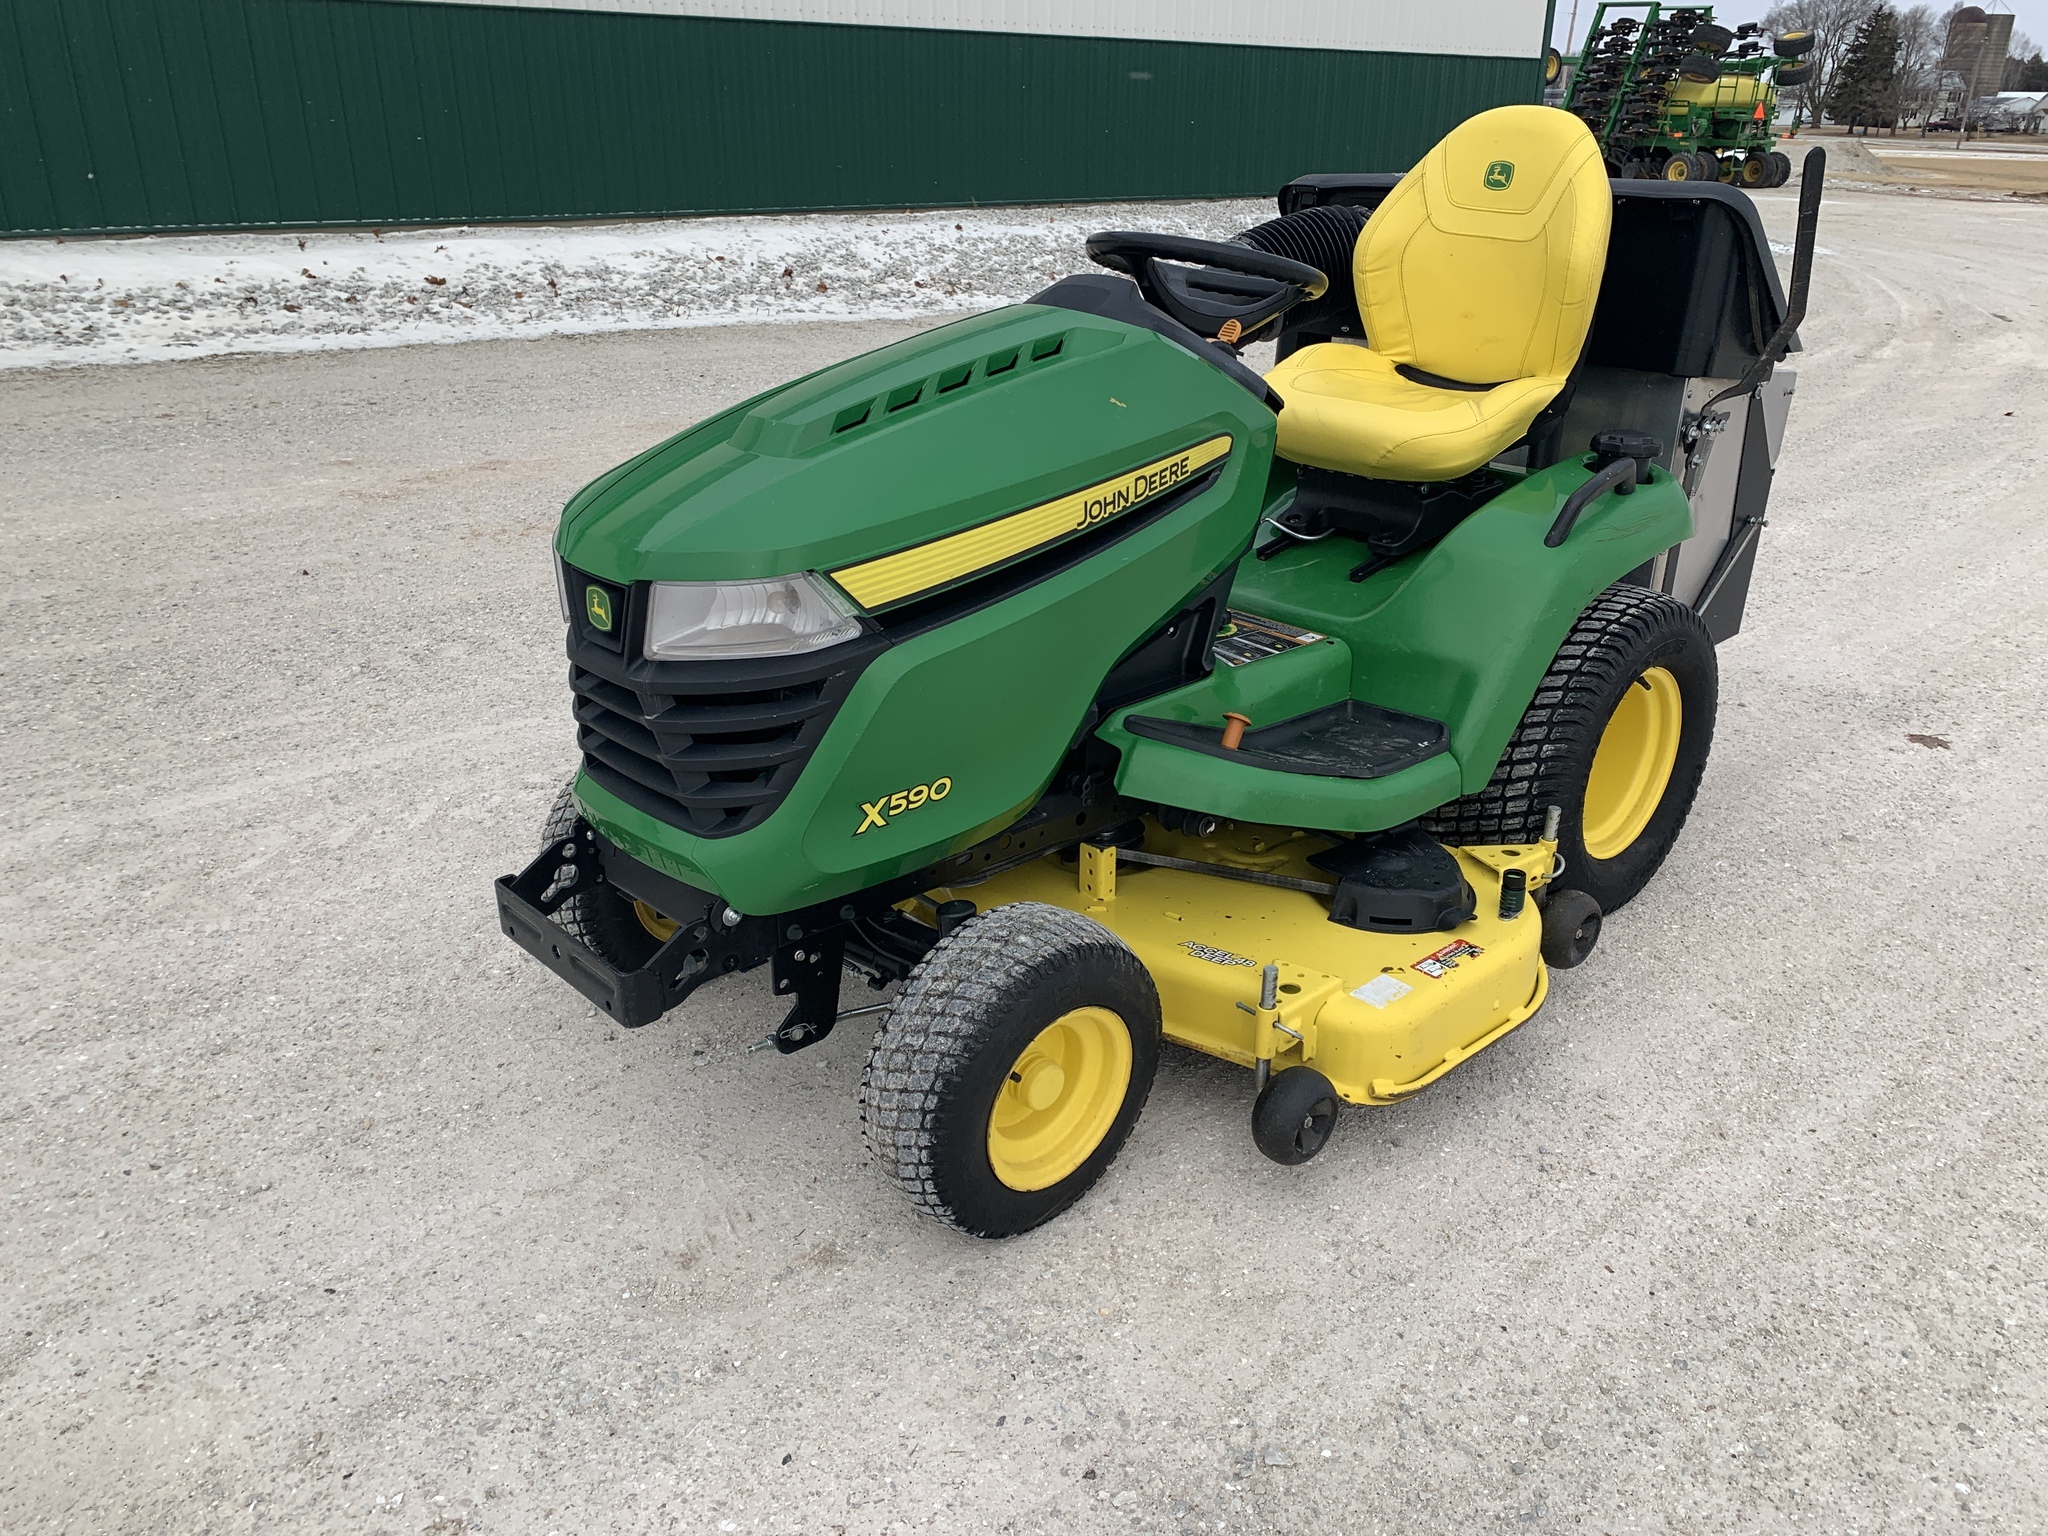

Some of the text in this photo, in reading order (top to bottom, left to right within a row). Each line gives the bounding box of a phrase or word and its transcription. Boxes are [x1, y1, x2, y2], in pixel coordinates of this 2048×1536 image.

[1077, 456, 1190, 527] JOHN DEERE
[853, 776, 952, 837] X590
[1178, 941, 1233, 959] ACCEL
[1189, 950, 1236, 966] DEEP
